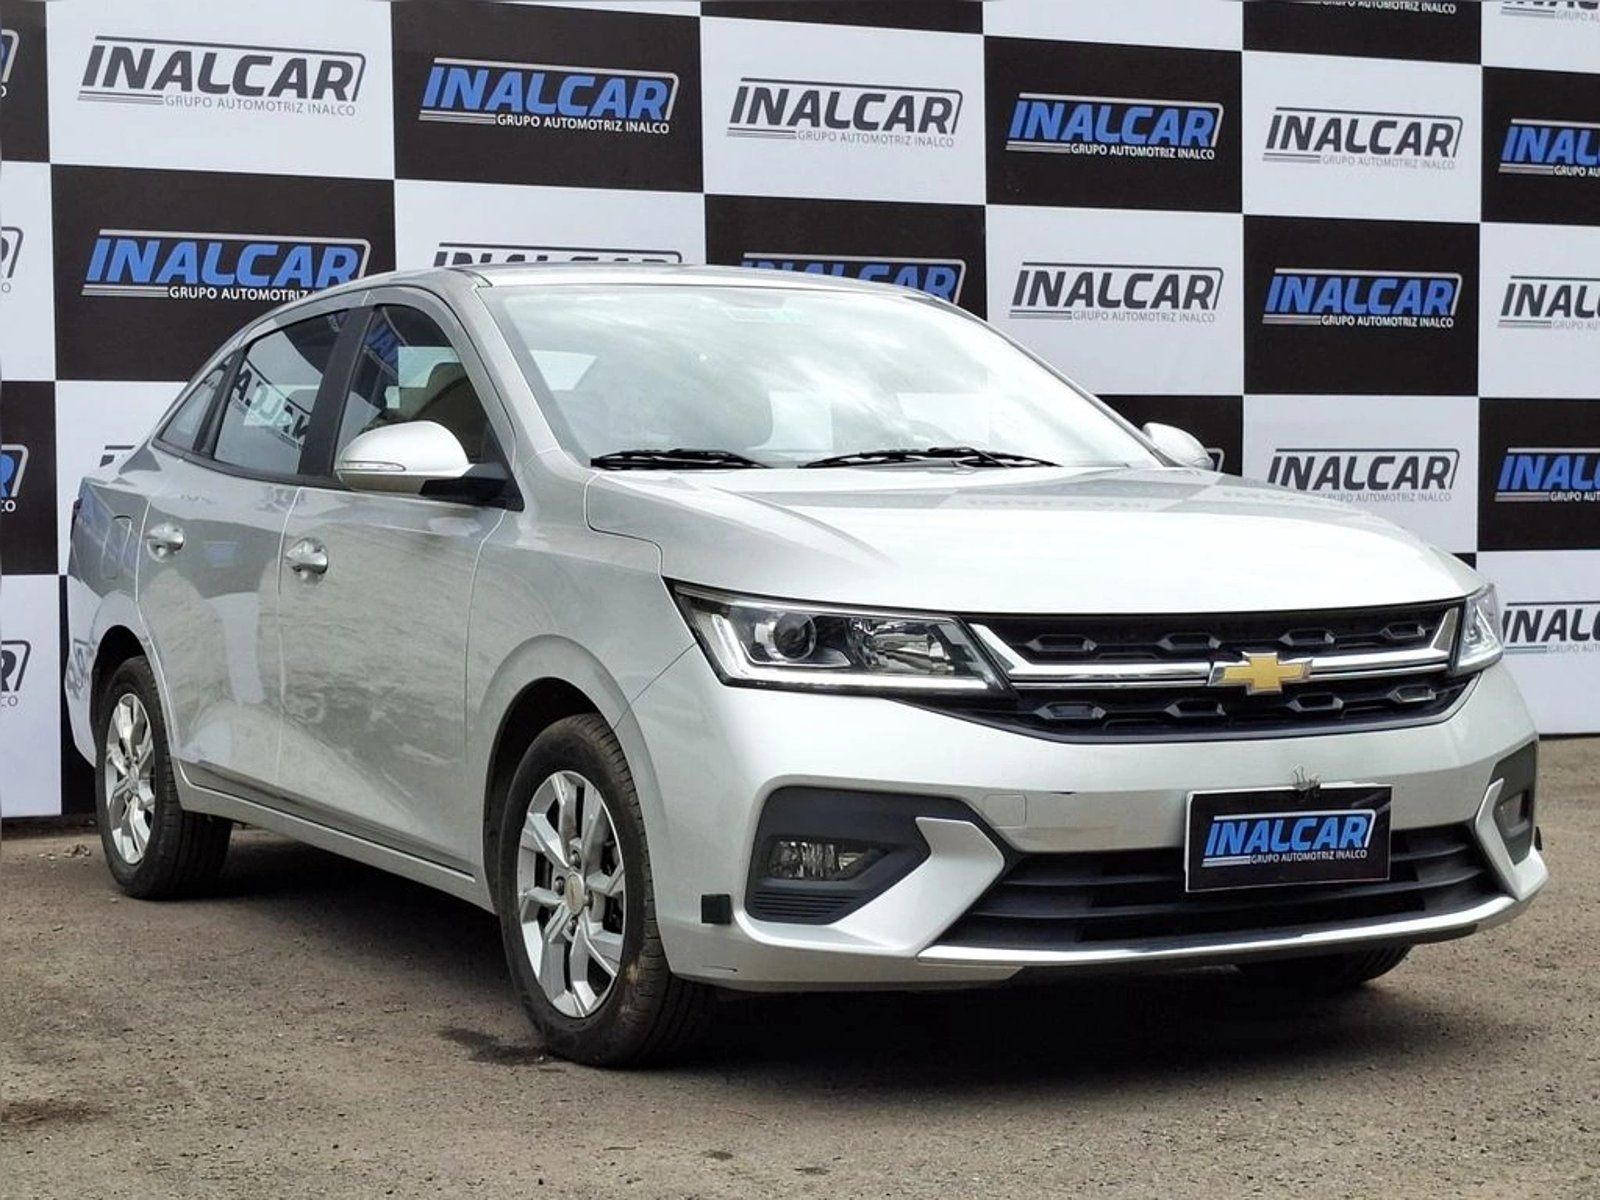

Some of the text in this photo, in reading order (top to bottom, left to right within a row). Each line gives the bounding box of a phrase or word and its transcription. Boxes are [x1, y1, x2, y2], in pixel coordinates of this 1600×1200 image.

[1421, 3, 1456, 14] INALCO
[81, 45, 354, 101] INALCAR
[421, 66, 671, 120] INALCAR
[165, 94, 357, 117] GRUPO AUTOMOTRIZ INALCO
[730, 86, 953, 134] INALCAR
[497, 114, 670, 135] GRUPO AUTOMOTRIZ INALCO
[1008, 100, 1215, 146] INALCAR
[797, 130, 955, 148] GRUPO AUTOMOTRIZ INALCO
[1266, 114, 1454, 157] INALCAR
[1501, 126, 1600, 166] INAL
[1071, 143, 1215, 160] GRUPO AUTOMOTRIZ INALCO
[1323, 155, 1455, 169] GRUPO AUTOMOTRIZ INALCO
[1554, 165, 1586, 177] GRUPO
[86, 238, 359, 288] INALCAR
[169, 286, 308, 301] GRUPO AUTOMOTRIZ
[1012, 270, 1215, 310] INALCAR
[1265, 276, 1454, 316] INALCAR
[1501, 283, 1600, 318] INAL
[1073, 310, 1215, 323] GRUPO AUTOMOTRIZ INALCO
[1322, 314, 1453, 328] GRUPO AUTOMOTRIZ INALCO
[1267, 456, 1450, 491] INALCAR
[1355, 492, 1415, 502] AUTOMOTRIZ
[1417, 492, 1451, 502] INALCO
[1550, 491, 1582, 502] GRUPO
[1204, 817, 1368, 856] INALCAR
[1251, 850, 1367, 864] GRUPO AUTOMOTRIZ INALCO
